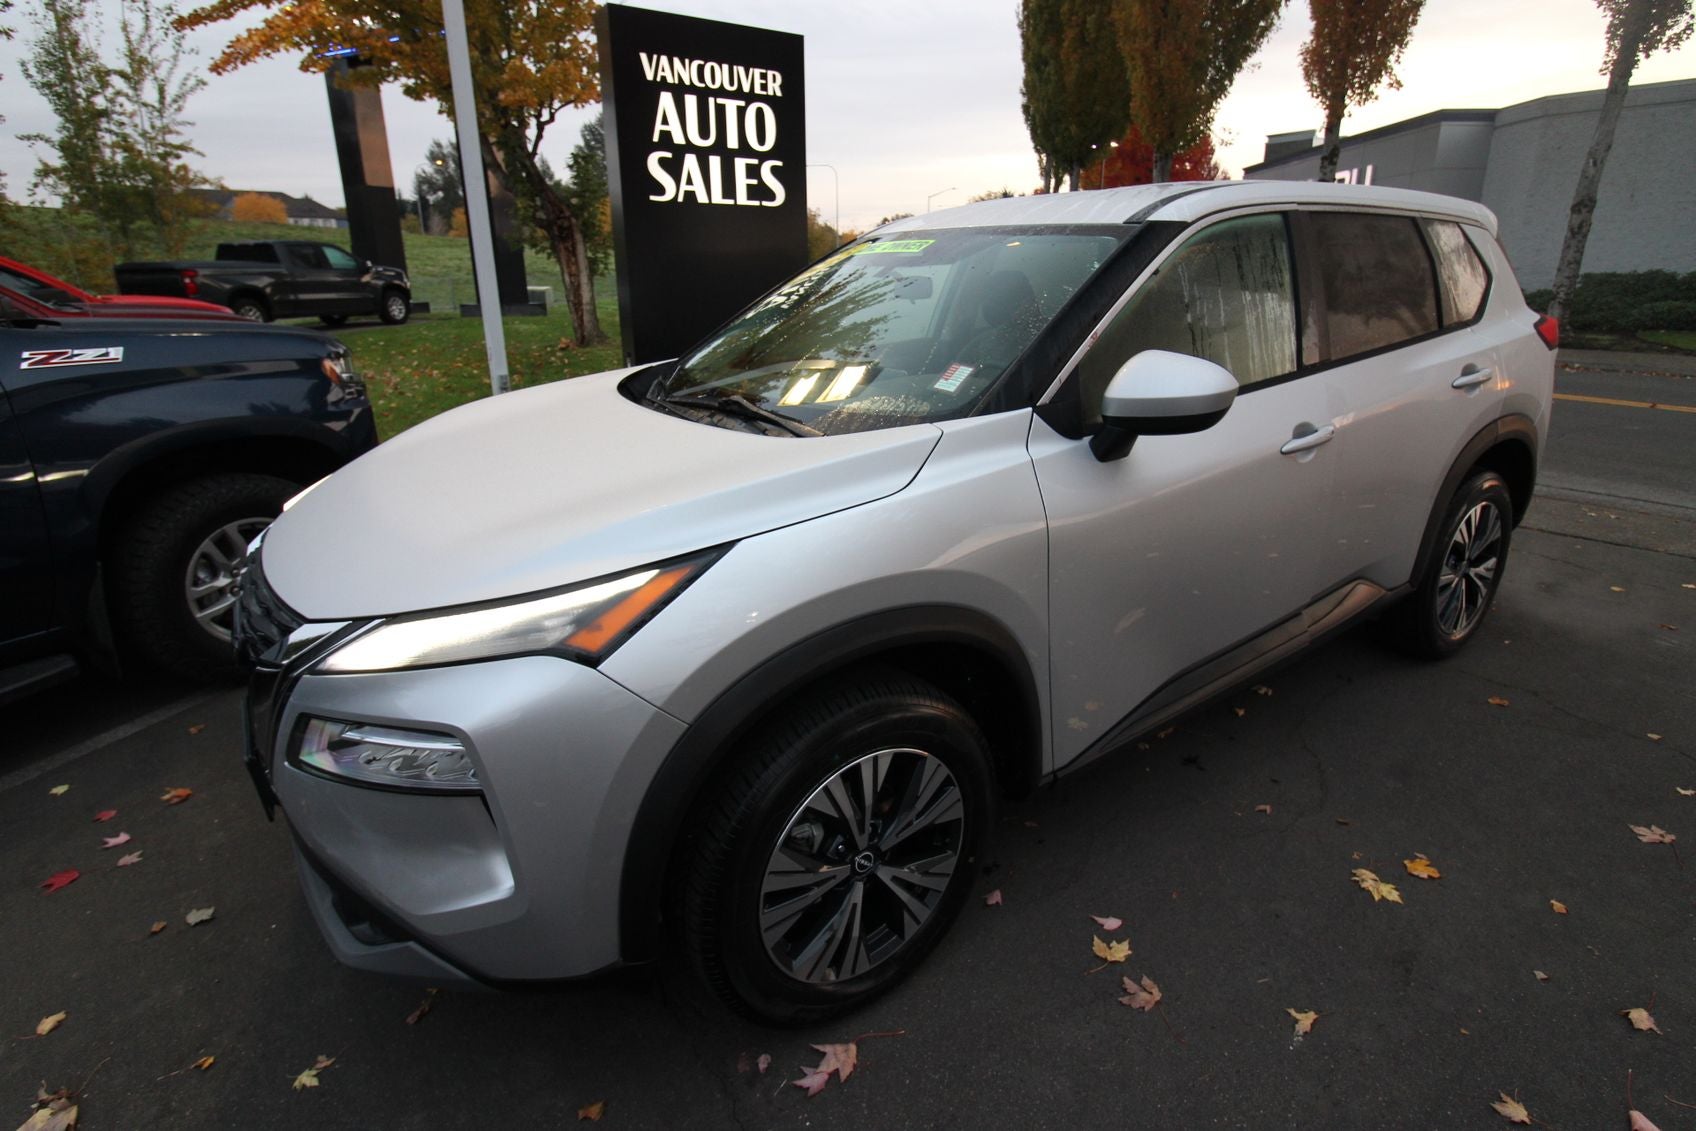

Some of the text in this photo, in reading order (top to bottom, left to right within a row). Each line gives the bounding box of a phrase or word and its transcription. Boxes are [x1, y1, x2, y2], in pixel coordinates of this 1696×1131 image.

[639, 52, 783, 97] VANCOUVER
[652, 91, 777, 152] AUTO
[647, 151, 786, 208] SALES
[20, 346, 124, 370] Z71
